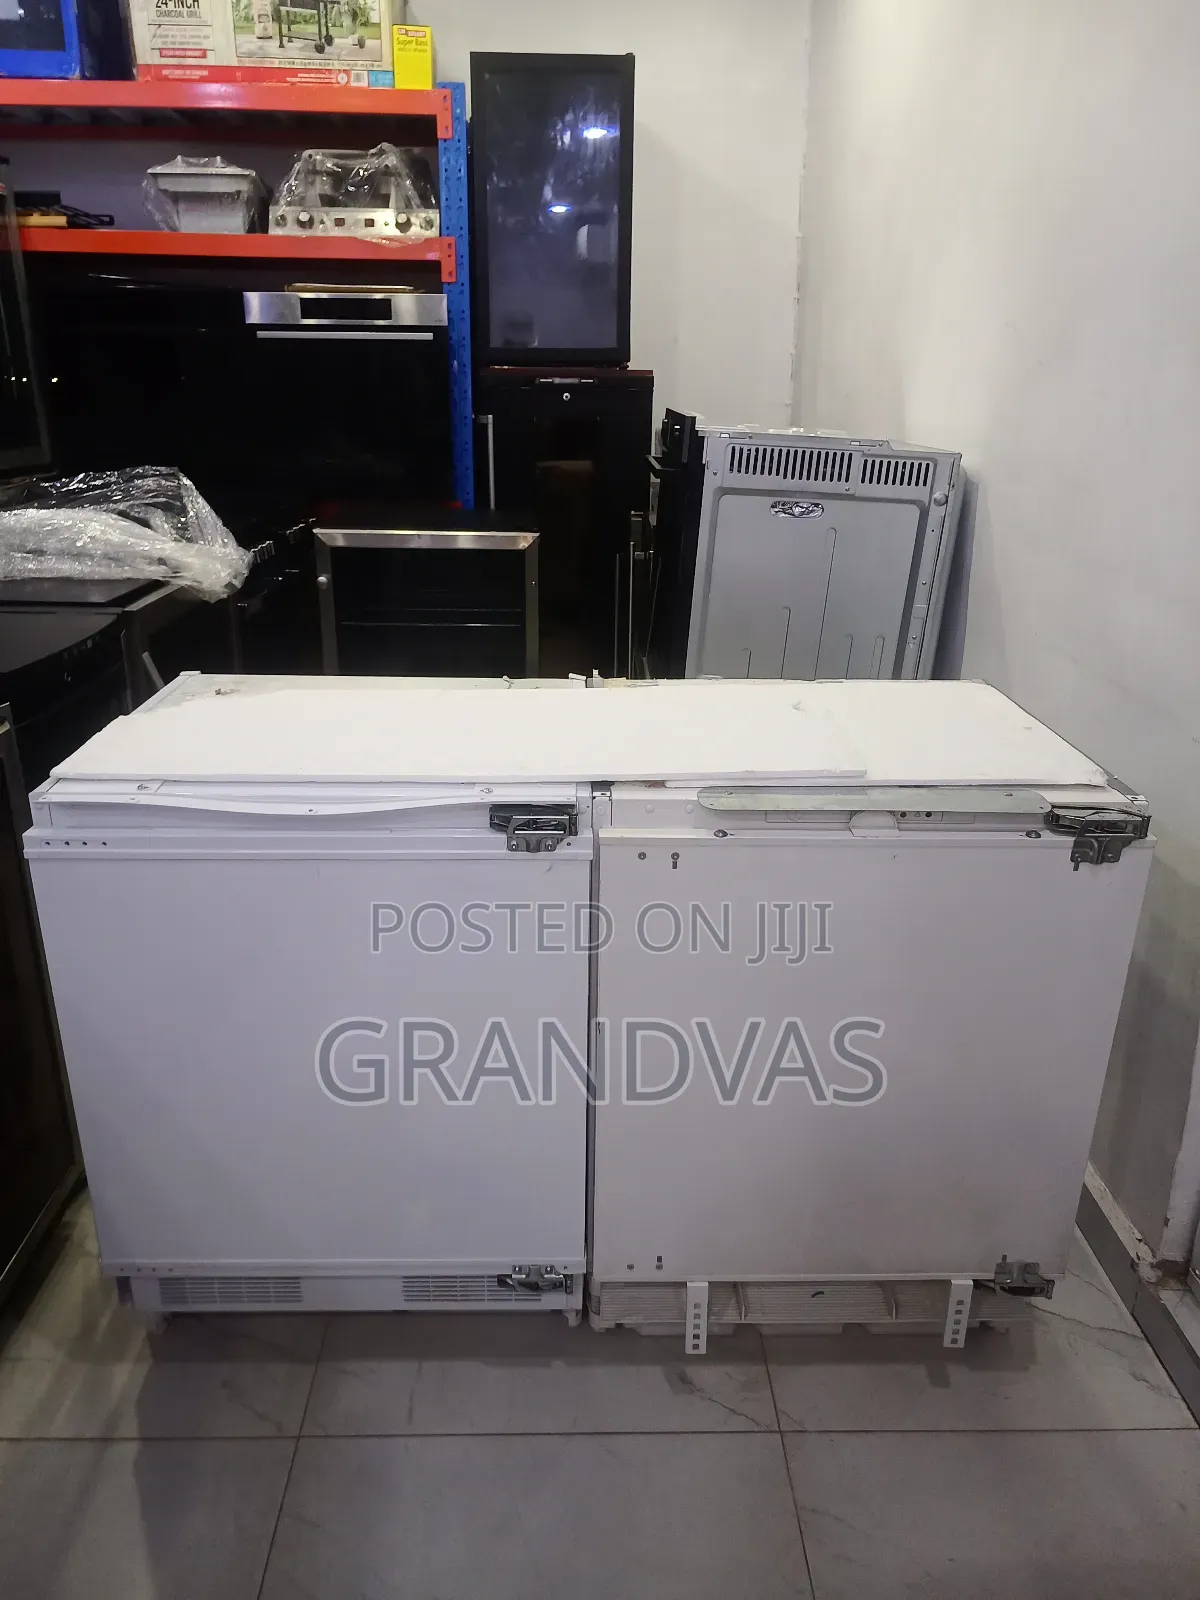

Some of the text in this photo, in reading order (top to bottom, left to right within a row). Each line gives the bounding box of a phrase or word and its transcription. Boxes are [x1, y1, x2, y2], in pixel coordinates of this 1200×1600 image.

[156, 0, 200, 9] 24-INCH
[156, 10, 202, 19] CHARCOAL GRILL
[396, 37, 428, 47] Super Bass
